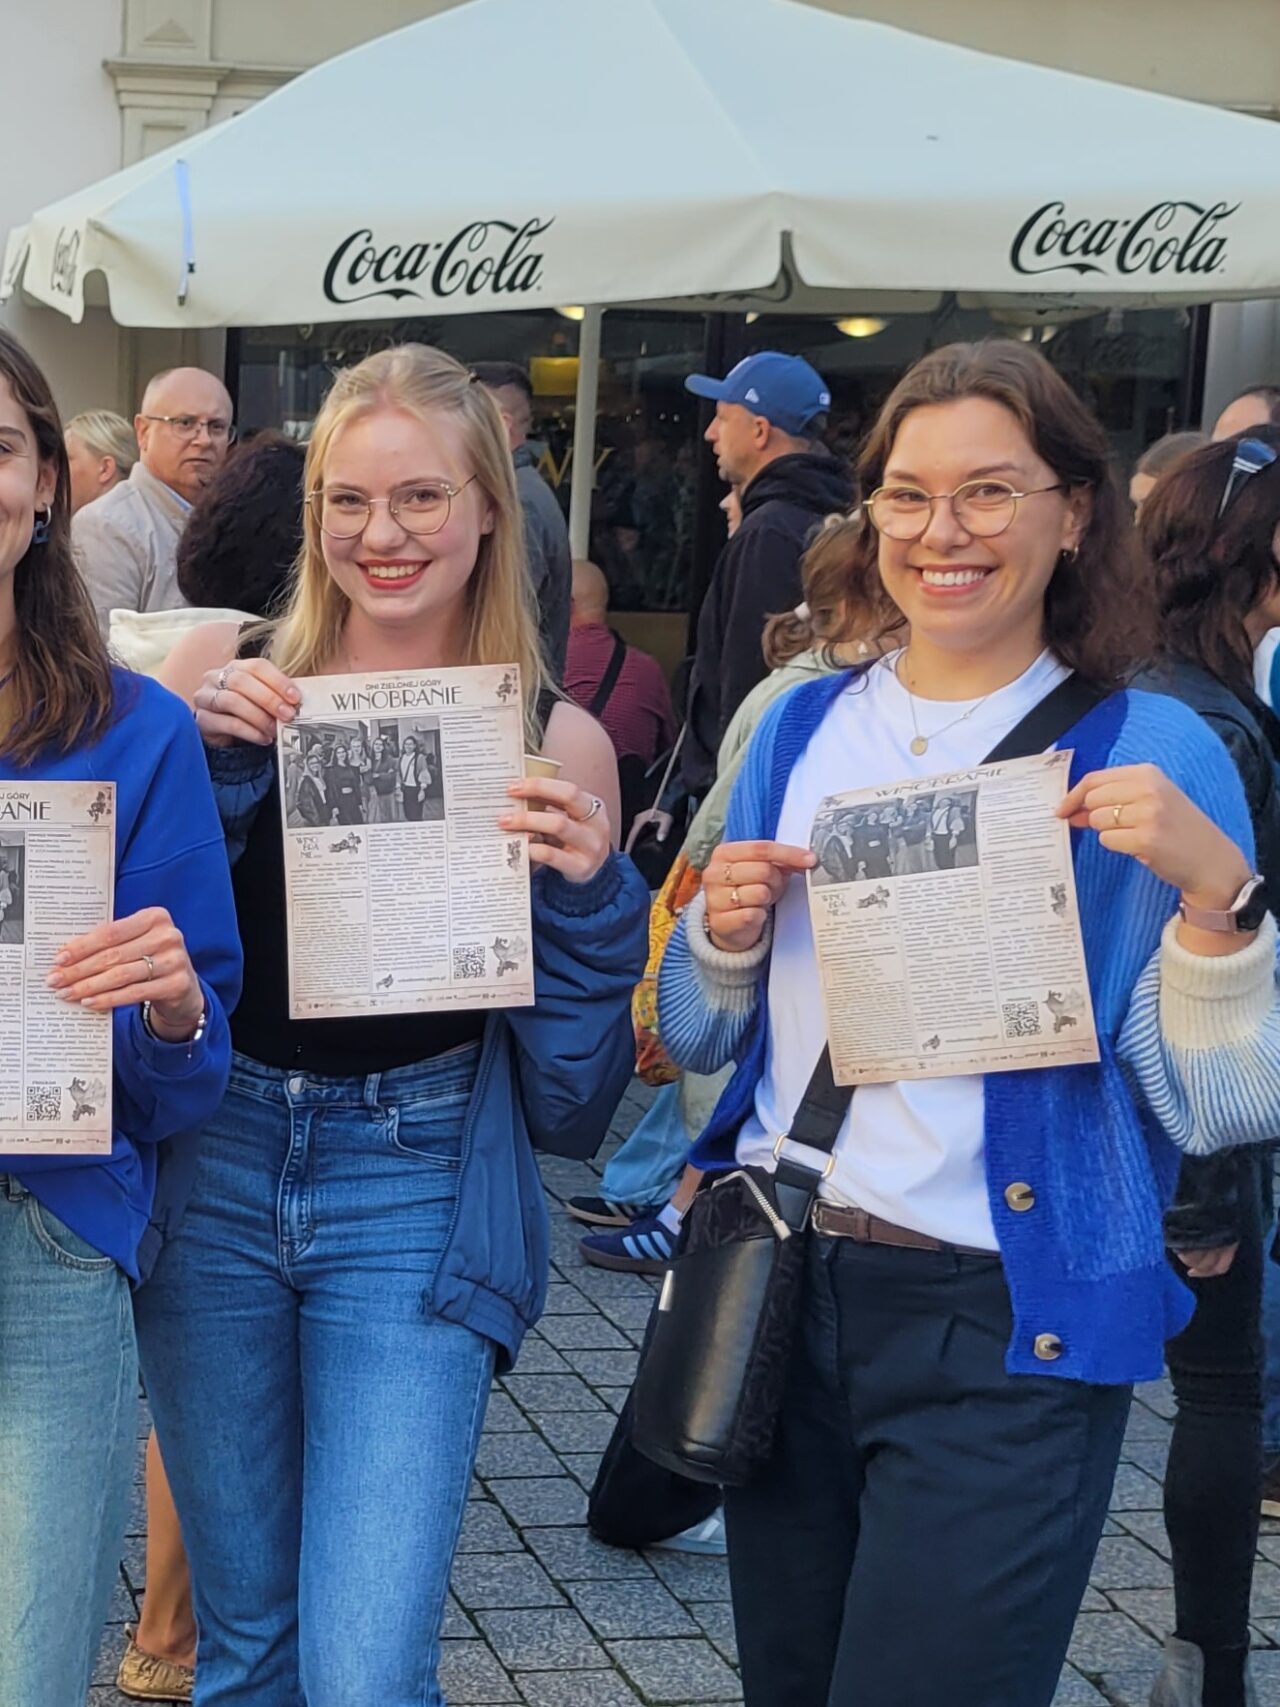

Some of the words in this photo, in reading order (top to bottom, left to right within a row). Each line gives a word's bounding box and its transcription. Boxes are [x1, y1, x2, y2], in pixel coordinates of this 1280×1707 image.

[323, 216, 556, 305] Coca-Cola
[1010, 201, 1242, 276] Coca-Cola
[331, 686, 463, 712] WINOBRANIE
[7, 791, 30, 800] GÓRY
